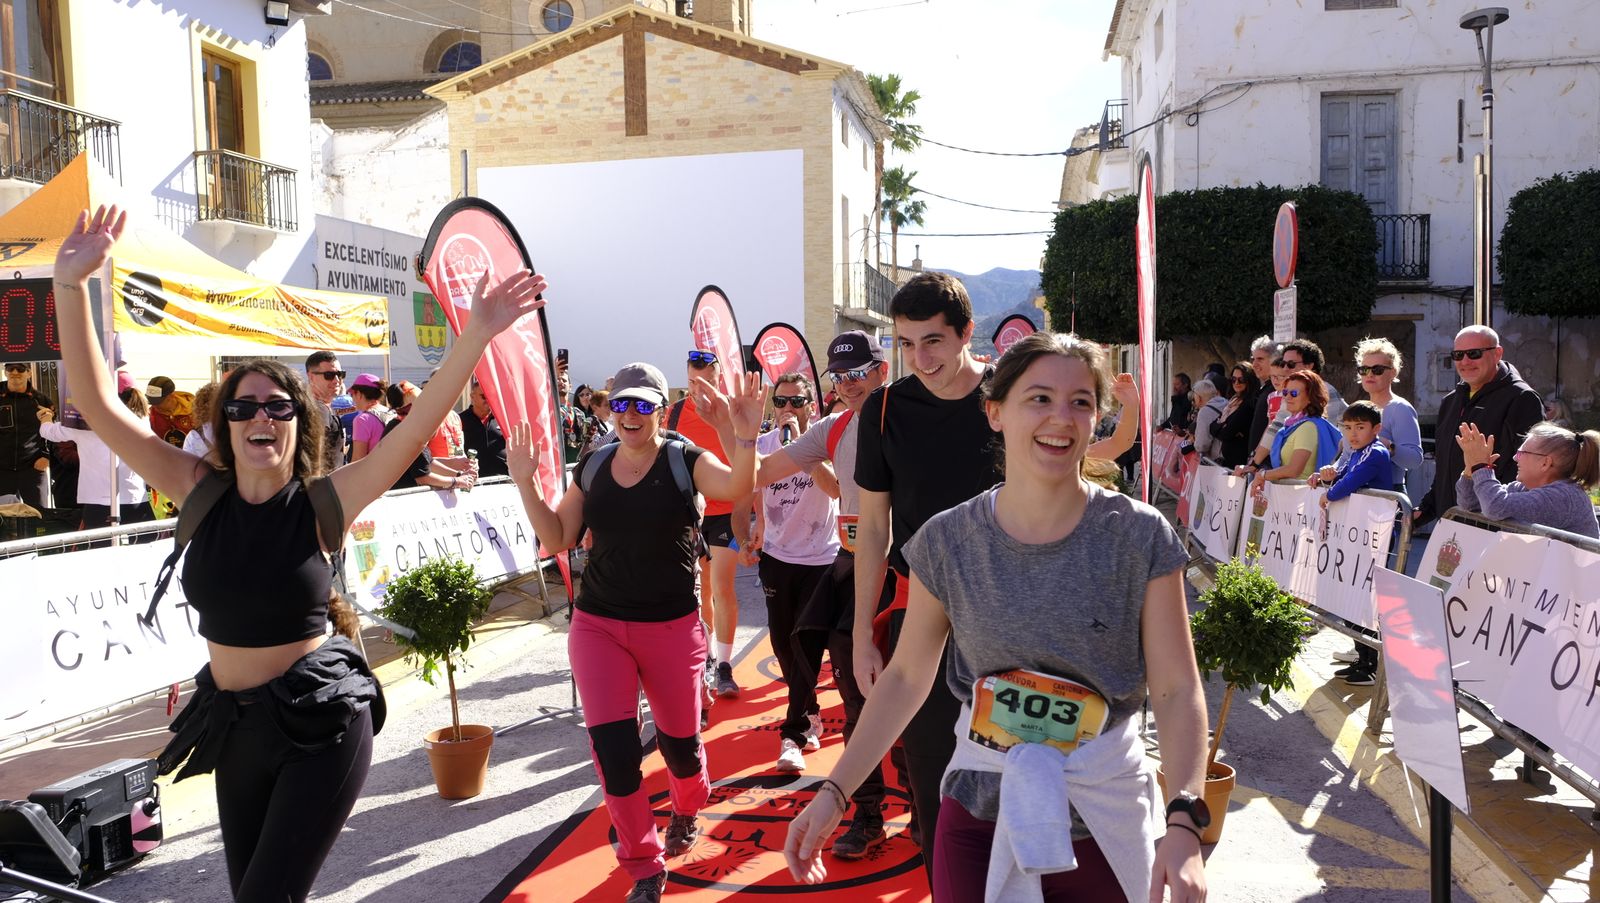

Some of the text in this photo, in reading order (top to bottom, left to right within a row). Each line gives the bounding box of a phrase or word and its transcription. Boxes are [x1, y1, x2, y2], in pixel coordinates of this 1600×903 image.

[325, 241, 408, 271] EXCELENTÍSIMO
[327, 270, 406, 297] AYUNTAMIENTO
[766, 482, 790, 495] epe
[395, 521, 527, 572] CANTORIA
[1363, 529, 1379, 549] DE
[1261, 530, 1376, 593] CANTORIA
[996, 687, 1080, 725] 403
[1020, 723, 1043, 732] MARTA
